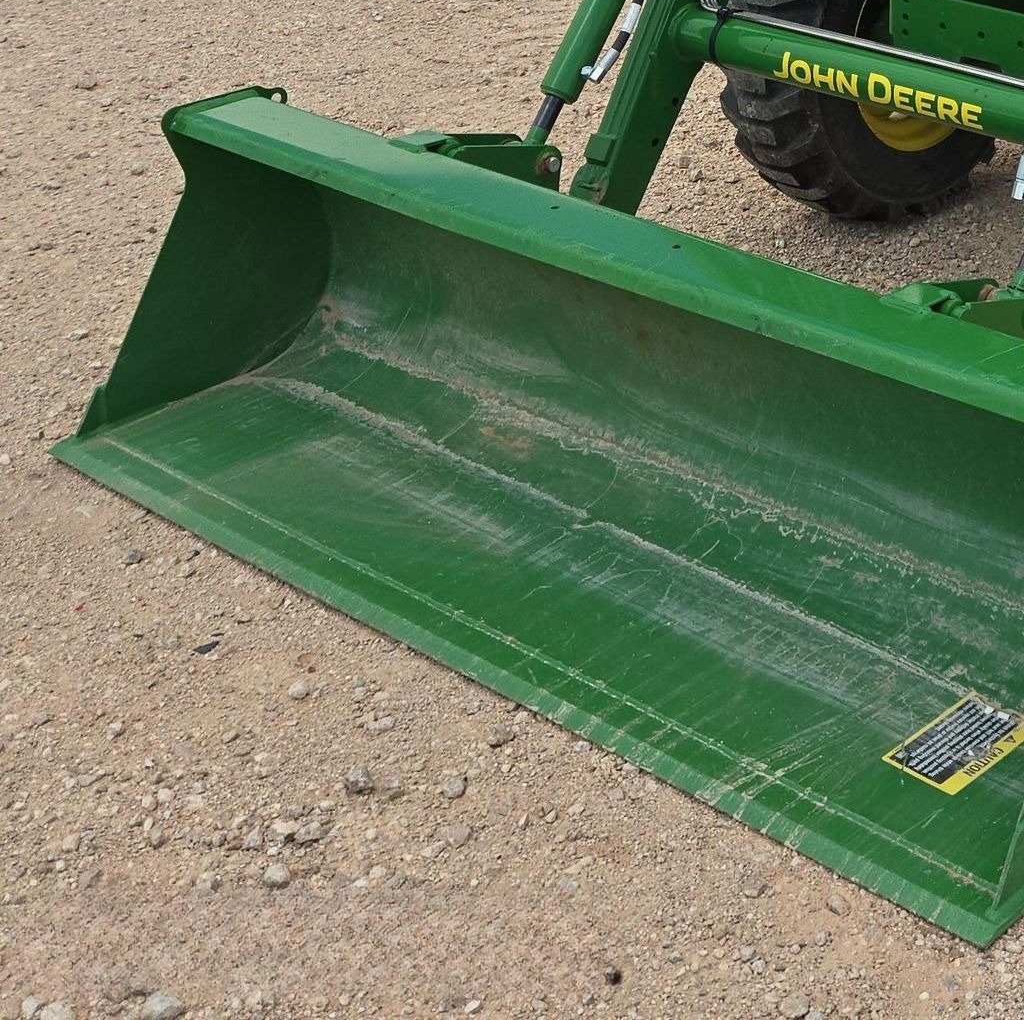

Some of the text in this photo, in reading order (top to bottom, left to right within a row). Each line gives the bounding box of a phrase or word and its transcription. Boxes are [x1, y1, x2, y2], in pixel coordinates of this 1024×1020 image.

[772, 51, 984, 130] JOHN DEERE
[962, 746, 1005, 777] CAUTION
